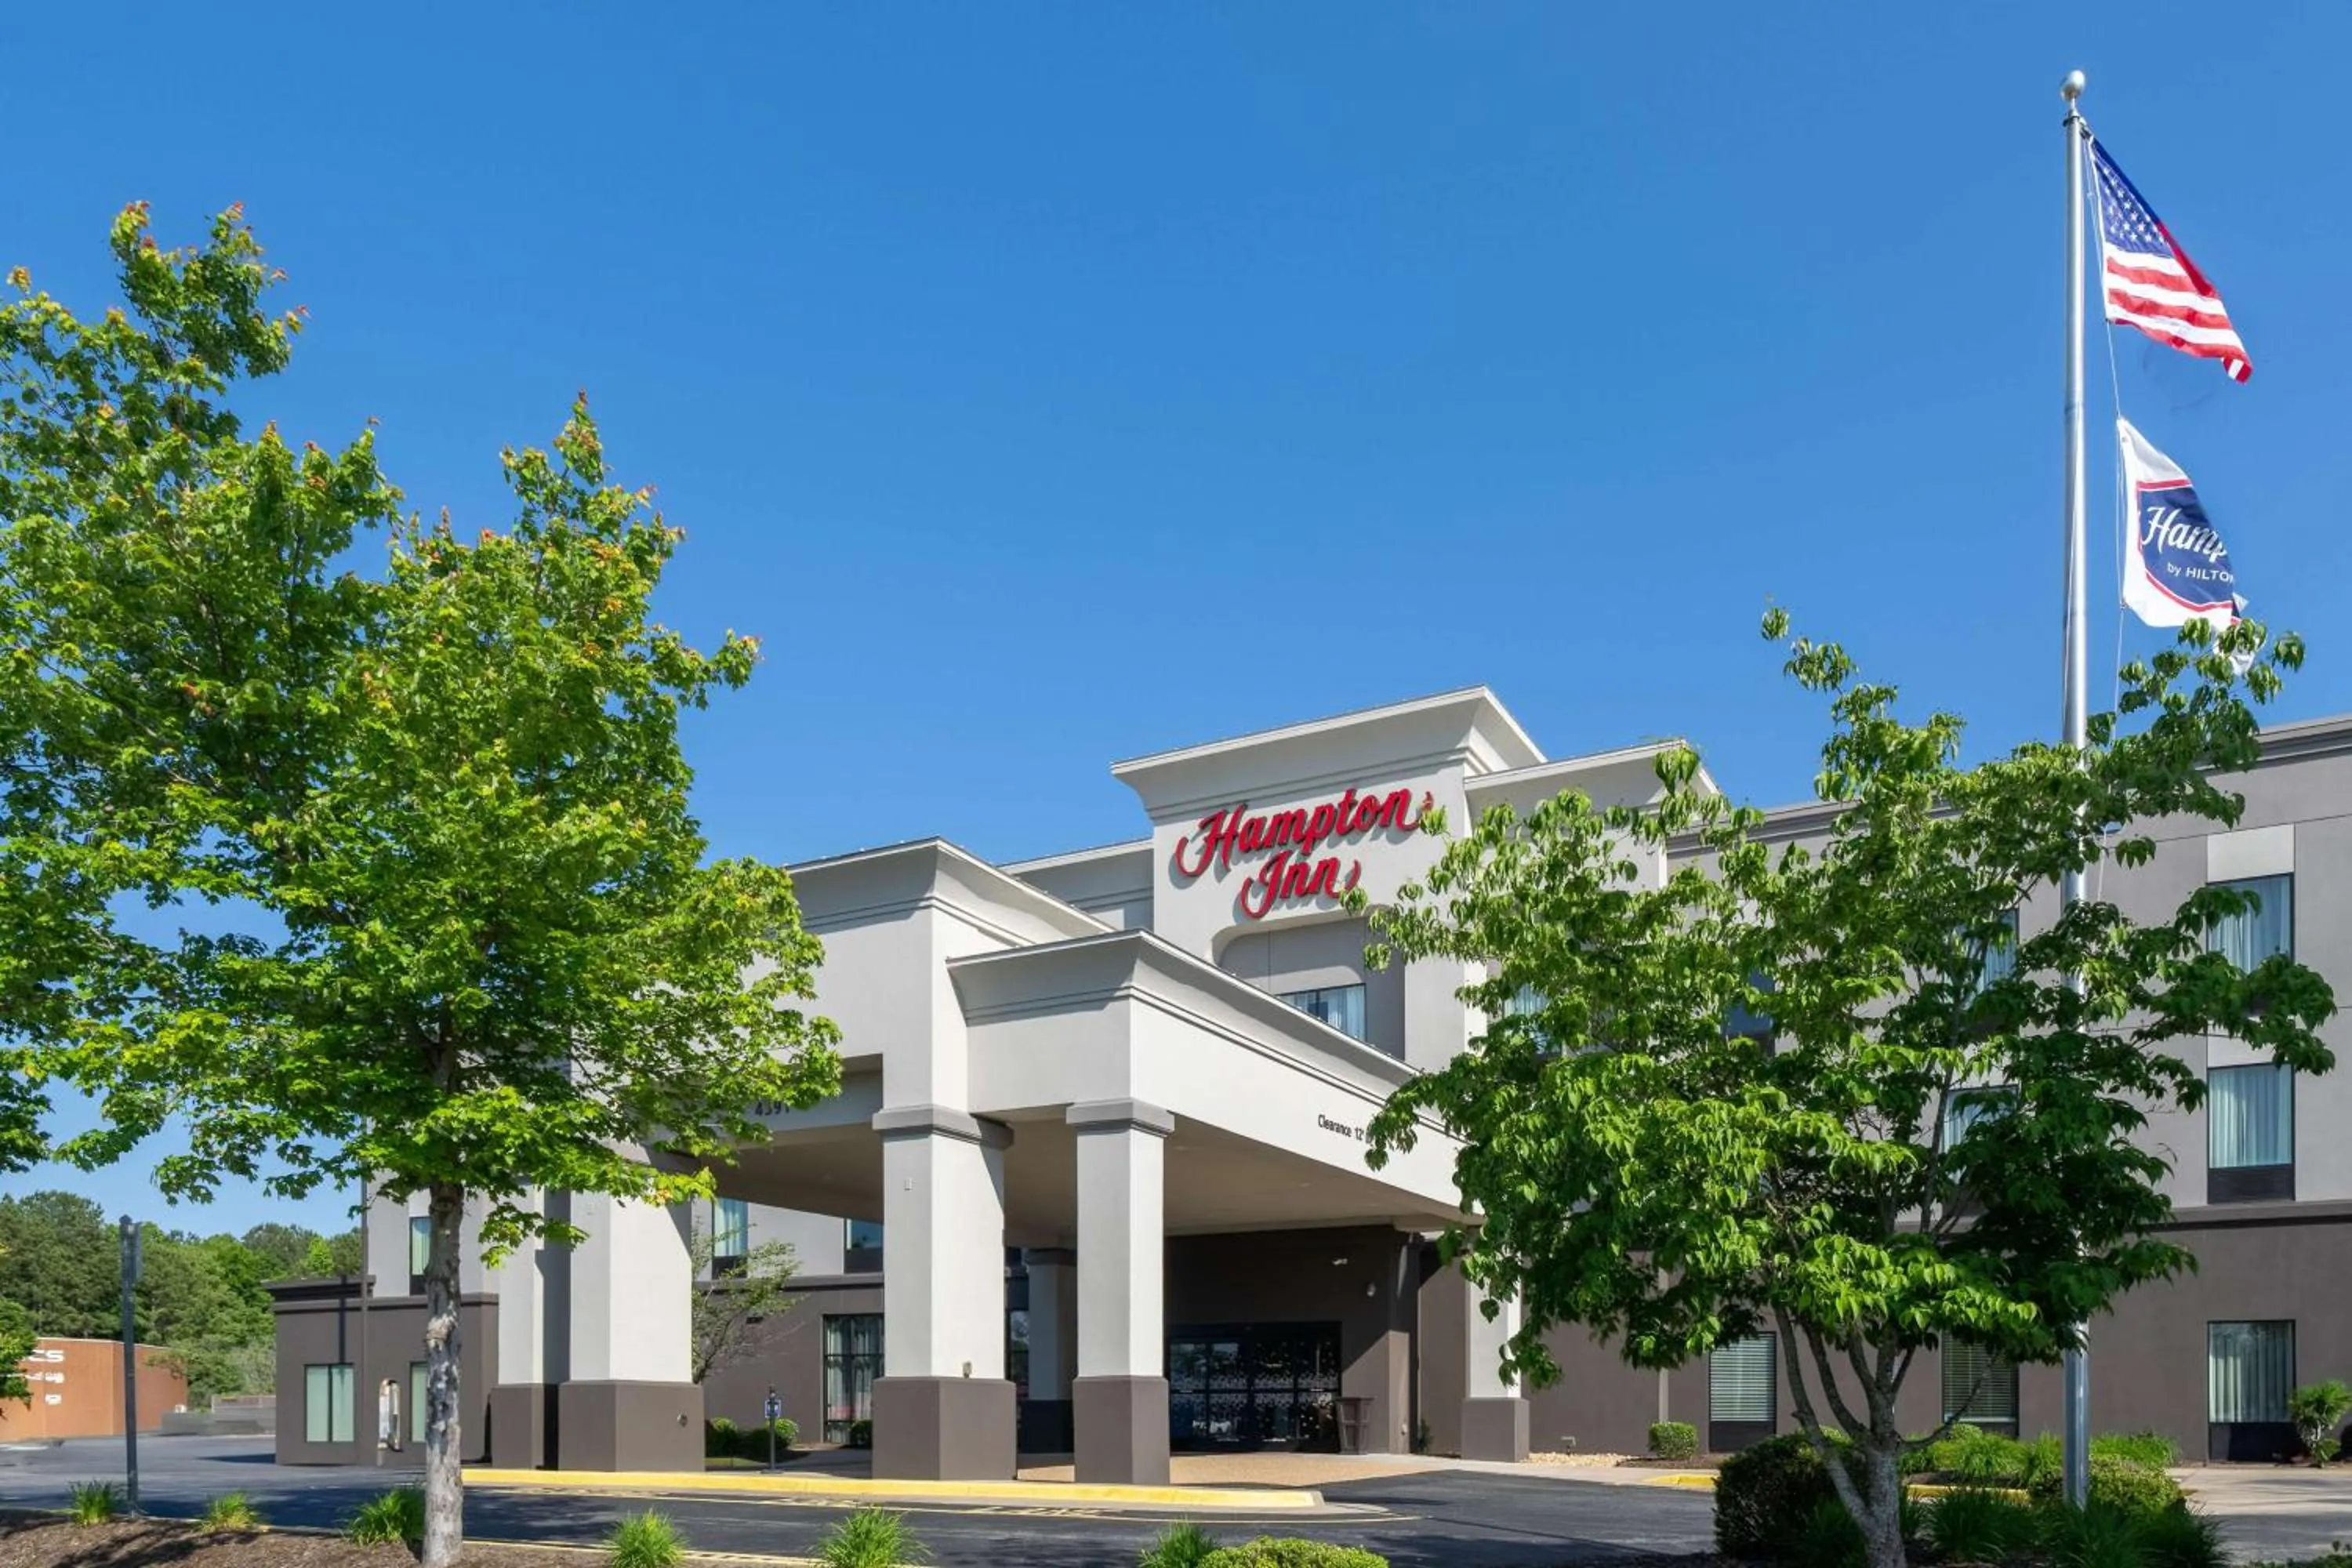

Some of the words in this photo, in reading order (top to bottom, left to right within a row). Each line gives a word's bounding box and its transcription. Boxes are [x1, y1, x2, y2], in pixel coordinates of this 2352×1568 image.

[2168, 562, 2182, 576] by
[1175, 787, 1434, 877] Hampton
[1240, 849, 1361, 920] Inn
[1318, 1114, 1352, 1138] Clearance
